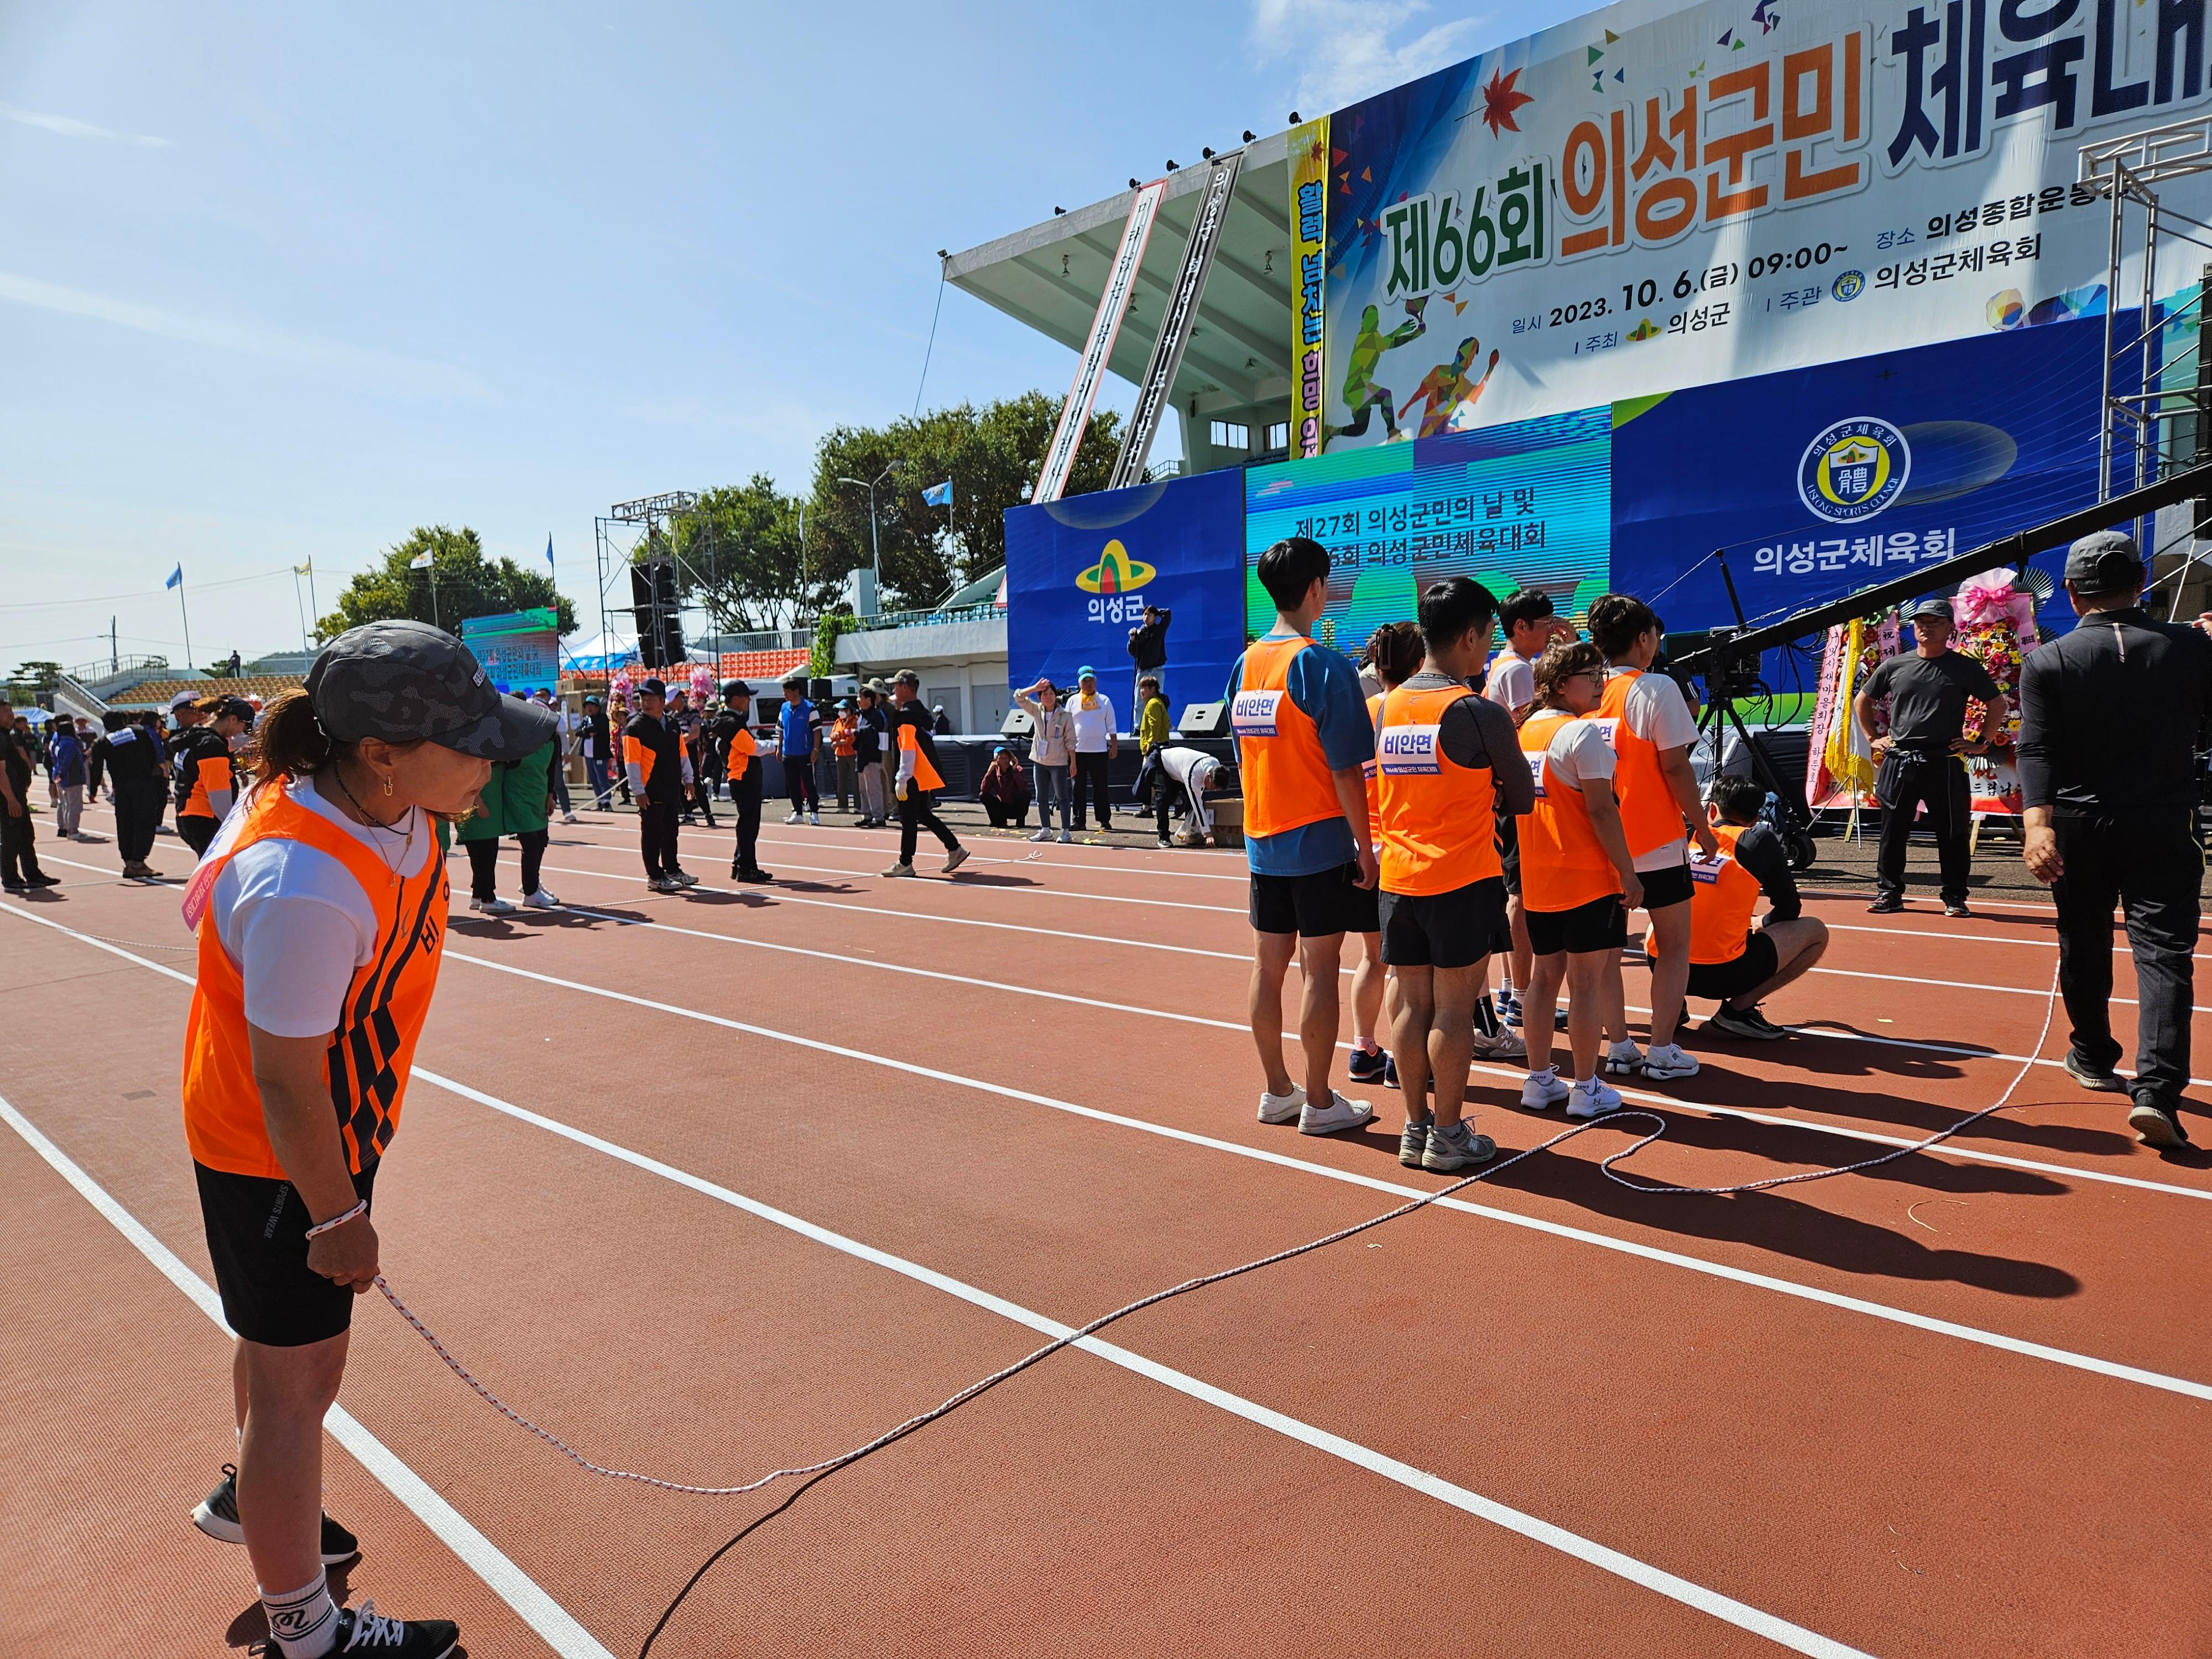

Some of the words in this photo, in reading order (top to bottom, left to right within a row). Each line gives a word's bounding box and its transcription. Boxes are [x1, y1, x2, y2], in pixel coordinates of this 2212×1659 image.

[1386, 163, 1543, 298] 제66회
[1561, 30, 1861, 258] 의성군민
[1887, 0, 2212, 168] 체육대
[1297, 179, 1323, 244] 활력
[1876, 227, 1916, 249] 장소
[1512, 315, 1541, 334] 일시
[1549, 297, 1613, 327] 2023.
[1622, 279, 1664, 311] 10.
[1748, 242, 1848, 279] 09:00~
[1779, 285, 1822, 310] 주관
[1874, 233, 2042, 290] 의성군체육회
[1301, 248, 1324, 346] 넘치는
[1585, 331, 1618, 352] 주최
[1667, 302, 1730, 335] 의성군
[1301, 348, 1321, 411] 희망
[1813, 424, 1897, 457] 의성군체육회
[1295, 511, 1359, 540] 제27회
[1368, 495, 1474, 533] 의성군민의
[1482, 491, 1504, 518] 날
[1514, 486, 1535, 515] 및
[1368, 520, 1547, 566] 의성군민체육대회
[1752, 528, 1955, 575] 의성군체육회
[1087, 594, 1145, 624] 의성군
[1236, 698, 1275, 717] 비안면
[1384, 734, 1432, 754] 비안면
[273, 1184, 289, 1214] SPORTS
